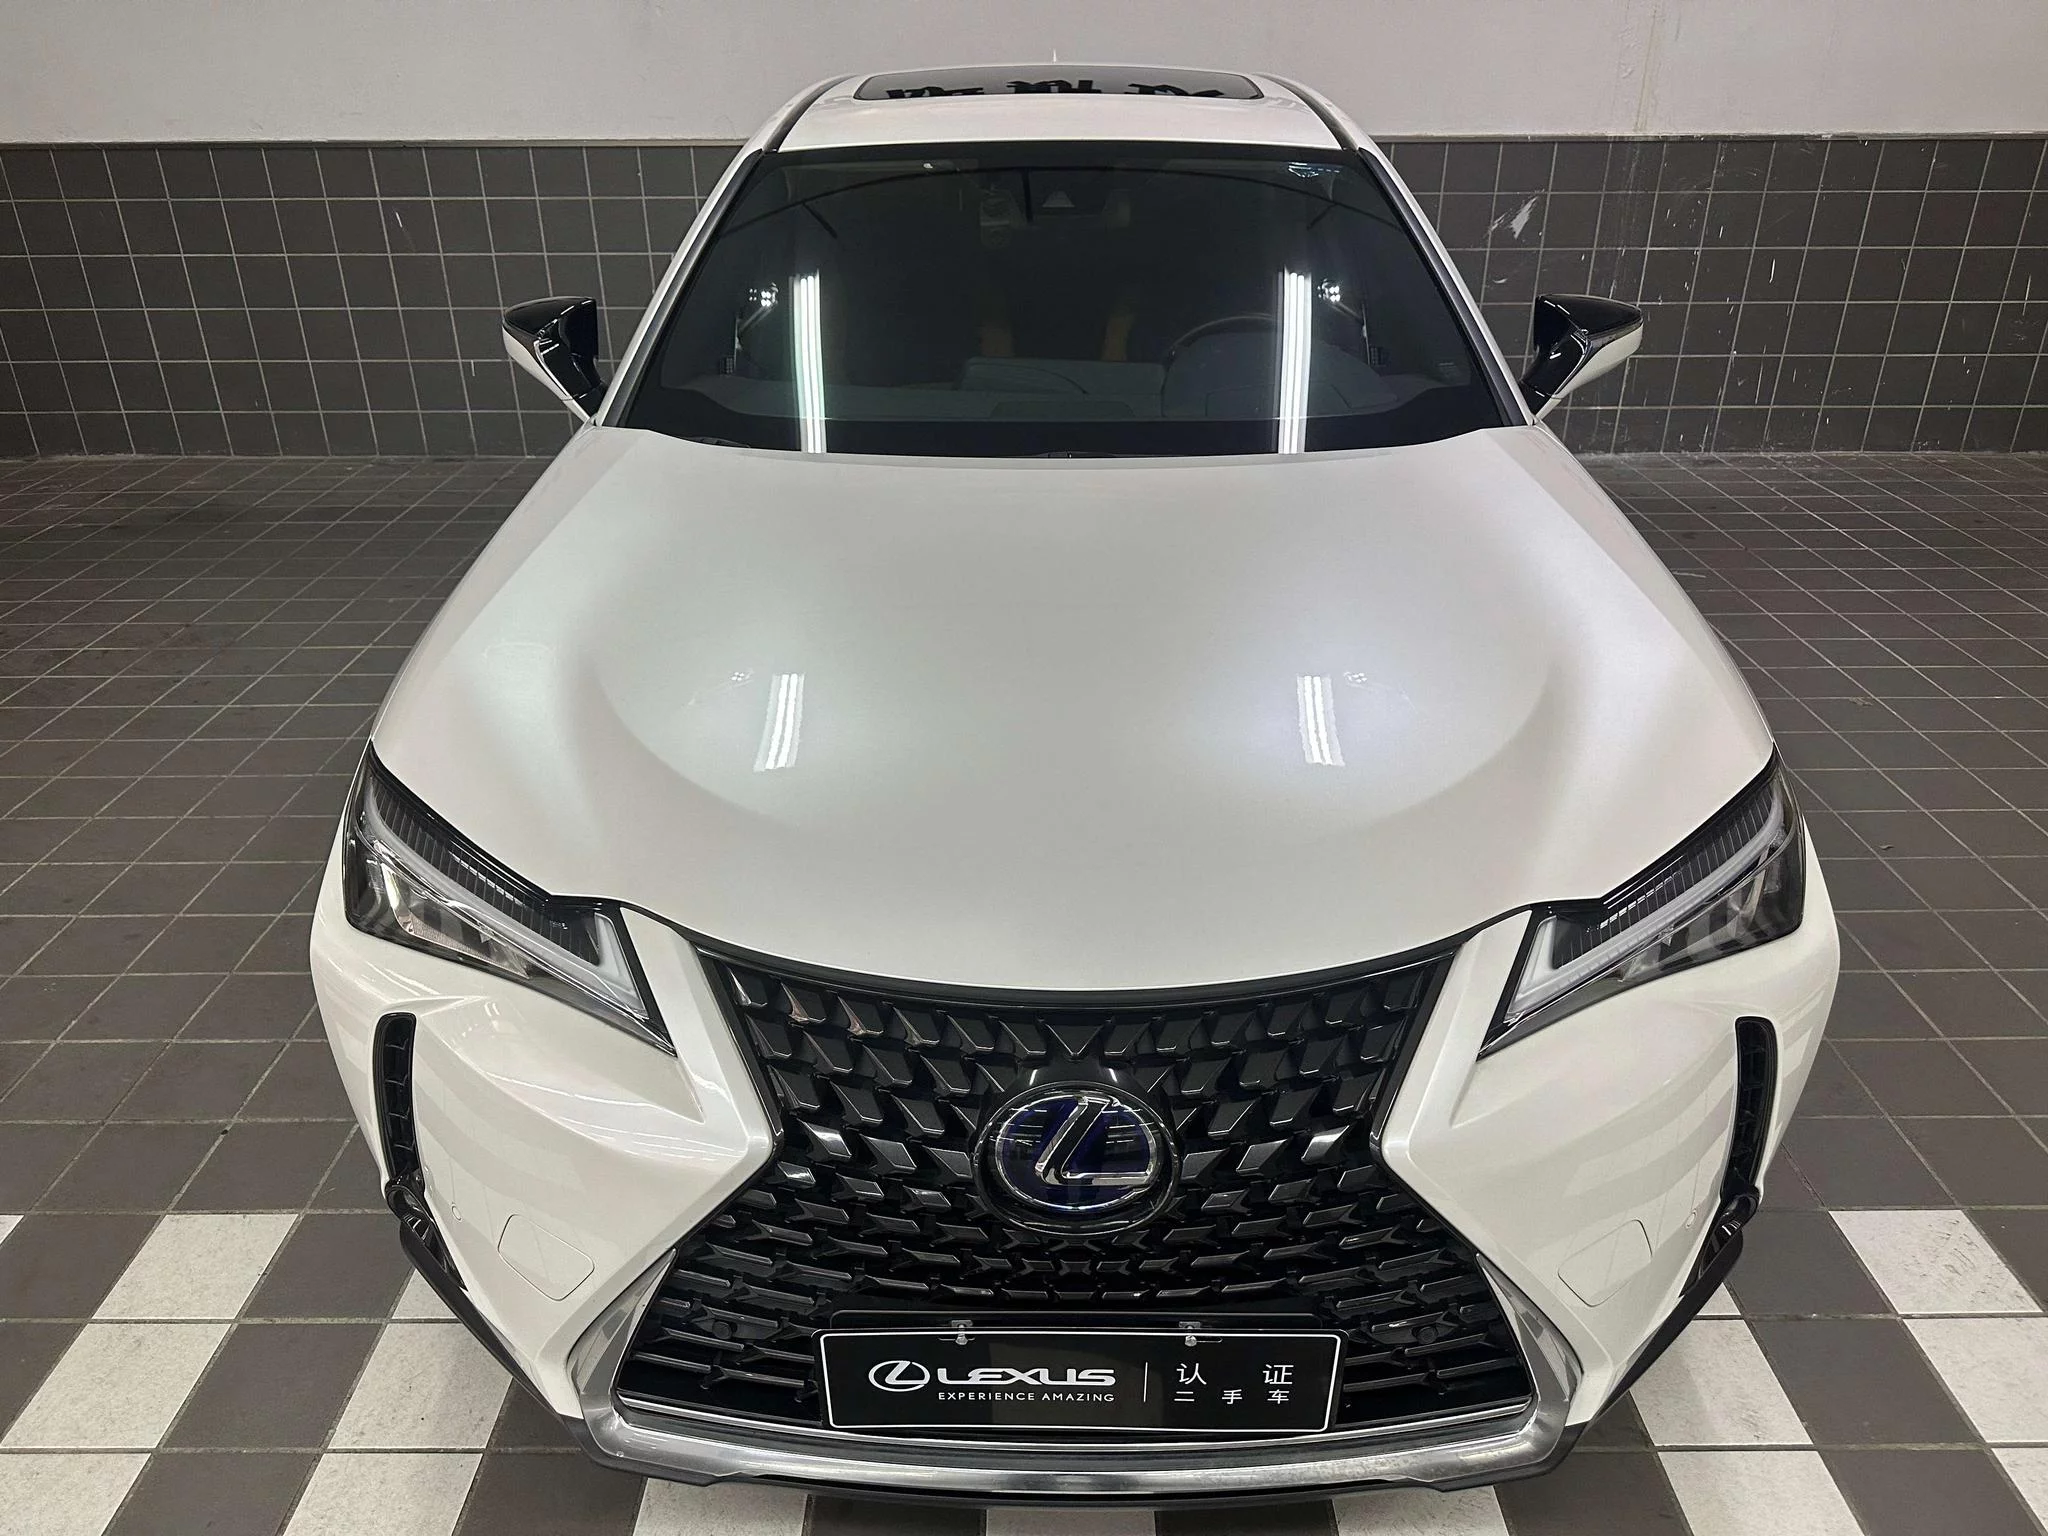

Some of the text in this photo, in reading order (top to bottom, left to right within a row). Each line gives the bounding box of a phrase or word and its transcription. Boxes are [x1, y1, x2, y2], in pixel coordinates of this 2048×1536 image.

[937, 1367, 1117, 1387] LEXUS
[1176, 1362, 1294, 1385] 认证
[937, 1391, 1116, 1403] EXPERIENCE AMAZING
[1173, 1388, 1291, 1405] 二手车
